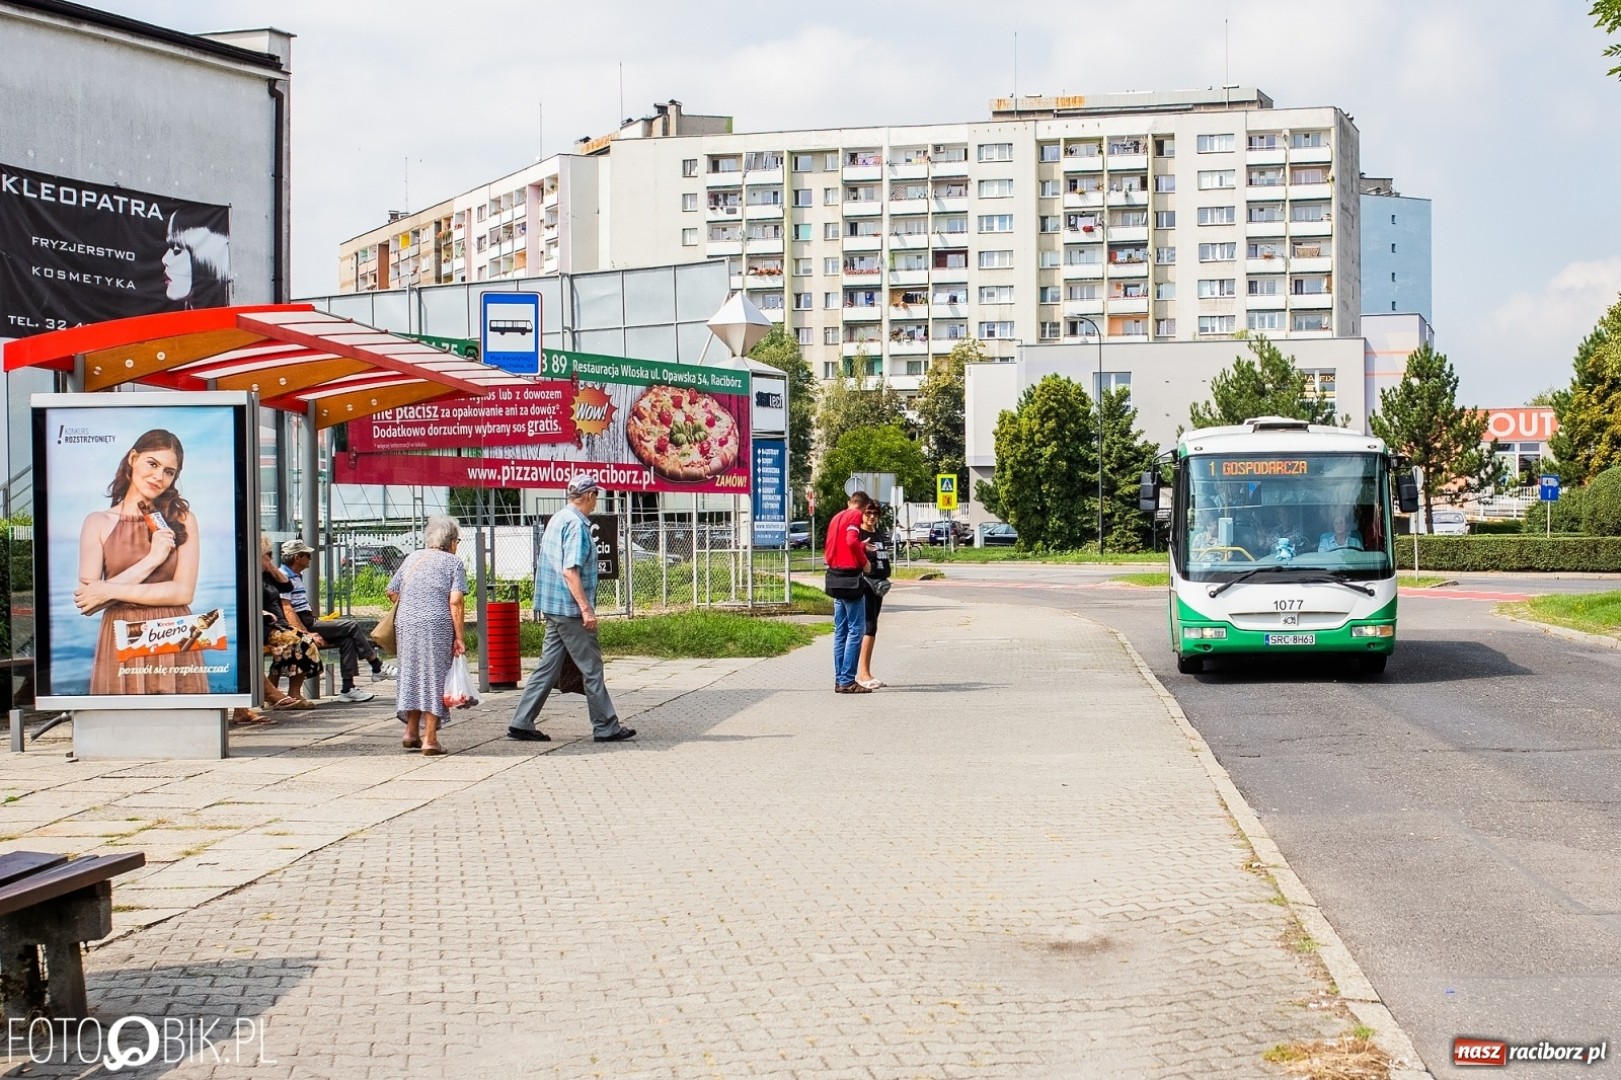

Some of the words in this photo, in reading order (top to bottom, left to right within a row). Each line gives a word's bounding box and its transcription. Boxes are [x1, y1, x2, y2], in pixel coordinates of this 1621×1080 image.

[2, 173, 164, 221] KLEOPATRA
[32, 236, 136, 262] FRYZJERSTWO
[32, 265, 136, 290] KOSMETYKA
[8, 315, 39, 328] TEL.
[45, 318, 67, 331] 32
[551, 354, 568, 374] 89
[572, 359, 620, 379] Restauracja
[620, 364, 650, 379] Włoska
[662, 369, 697, 385] Opawska
[697, 375, 709, 387] 54,
[710, 373, 743, 388] Racibórz
[499, 388, 513, 400] lub
[516, 391, 521, 400] z
[523, 388, 563, 400] dowozem
[440, 408, 451, 418] za
[452, 404, 504, 421] opakowanie
[505, 404, 518, 416] ani
[520, 407, 529, 416] za
[372, 424, 426, 438] Dodatkowo
[427, 422, 473, 438] dorzucimy
[474, 422, 511, 438] wybrany
[512, 423, 526, 433] sos
[527, 415, 562, 437] gratis.
[1209, 461, 1215, 476] 1
[1222, 460, 1308, 476] GOSPODARCZA
[1273, 599, 1304, 611] 1077
[148, 624, 188, 643] bueno
[1270, 634, 1290, 645] SRC
[118, 665, 153, 678] pozwól
[153, 665, 168, 677] się
[168, 663, 230, 677] rozpieszczać
